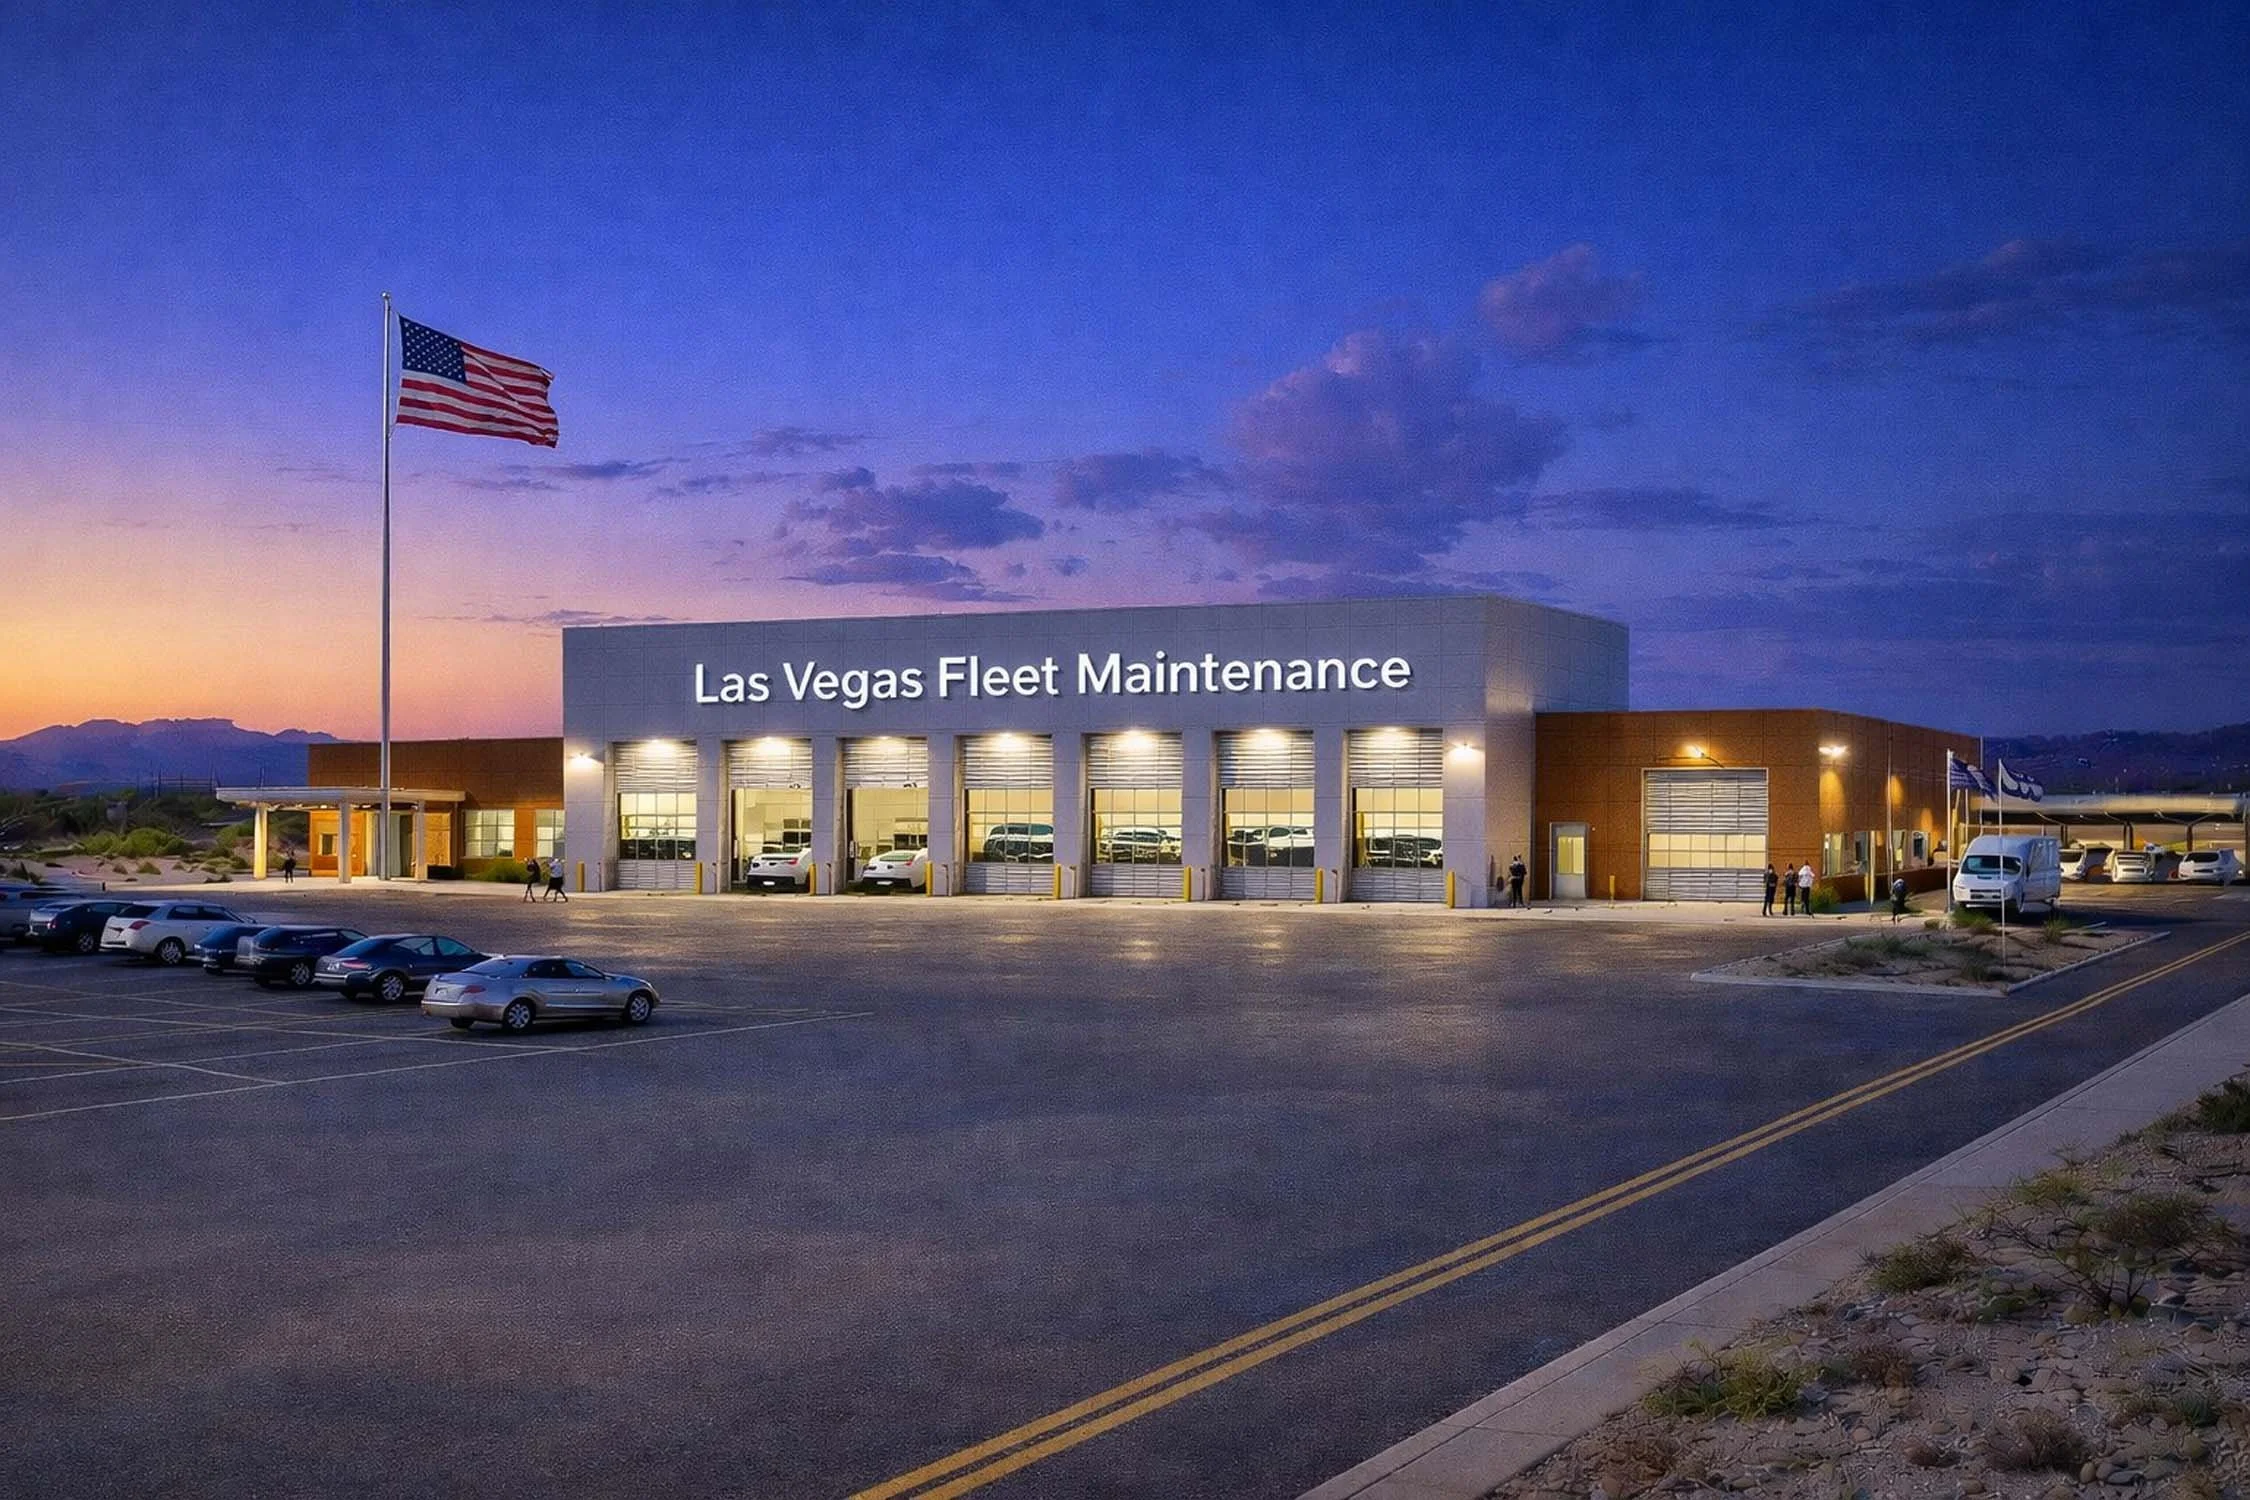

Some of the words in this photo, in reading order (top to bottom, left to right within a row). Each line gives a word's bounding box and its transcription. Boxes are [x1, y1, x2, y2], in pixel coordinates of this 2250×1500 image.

[694, 662, 770, 703] Las
[782, 660, 924, 709] Vegas
[938, 655, 1059, 698] Fleet
[1077, 650, 1412, 694] Maintenance
